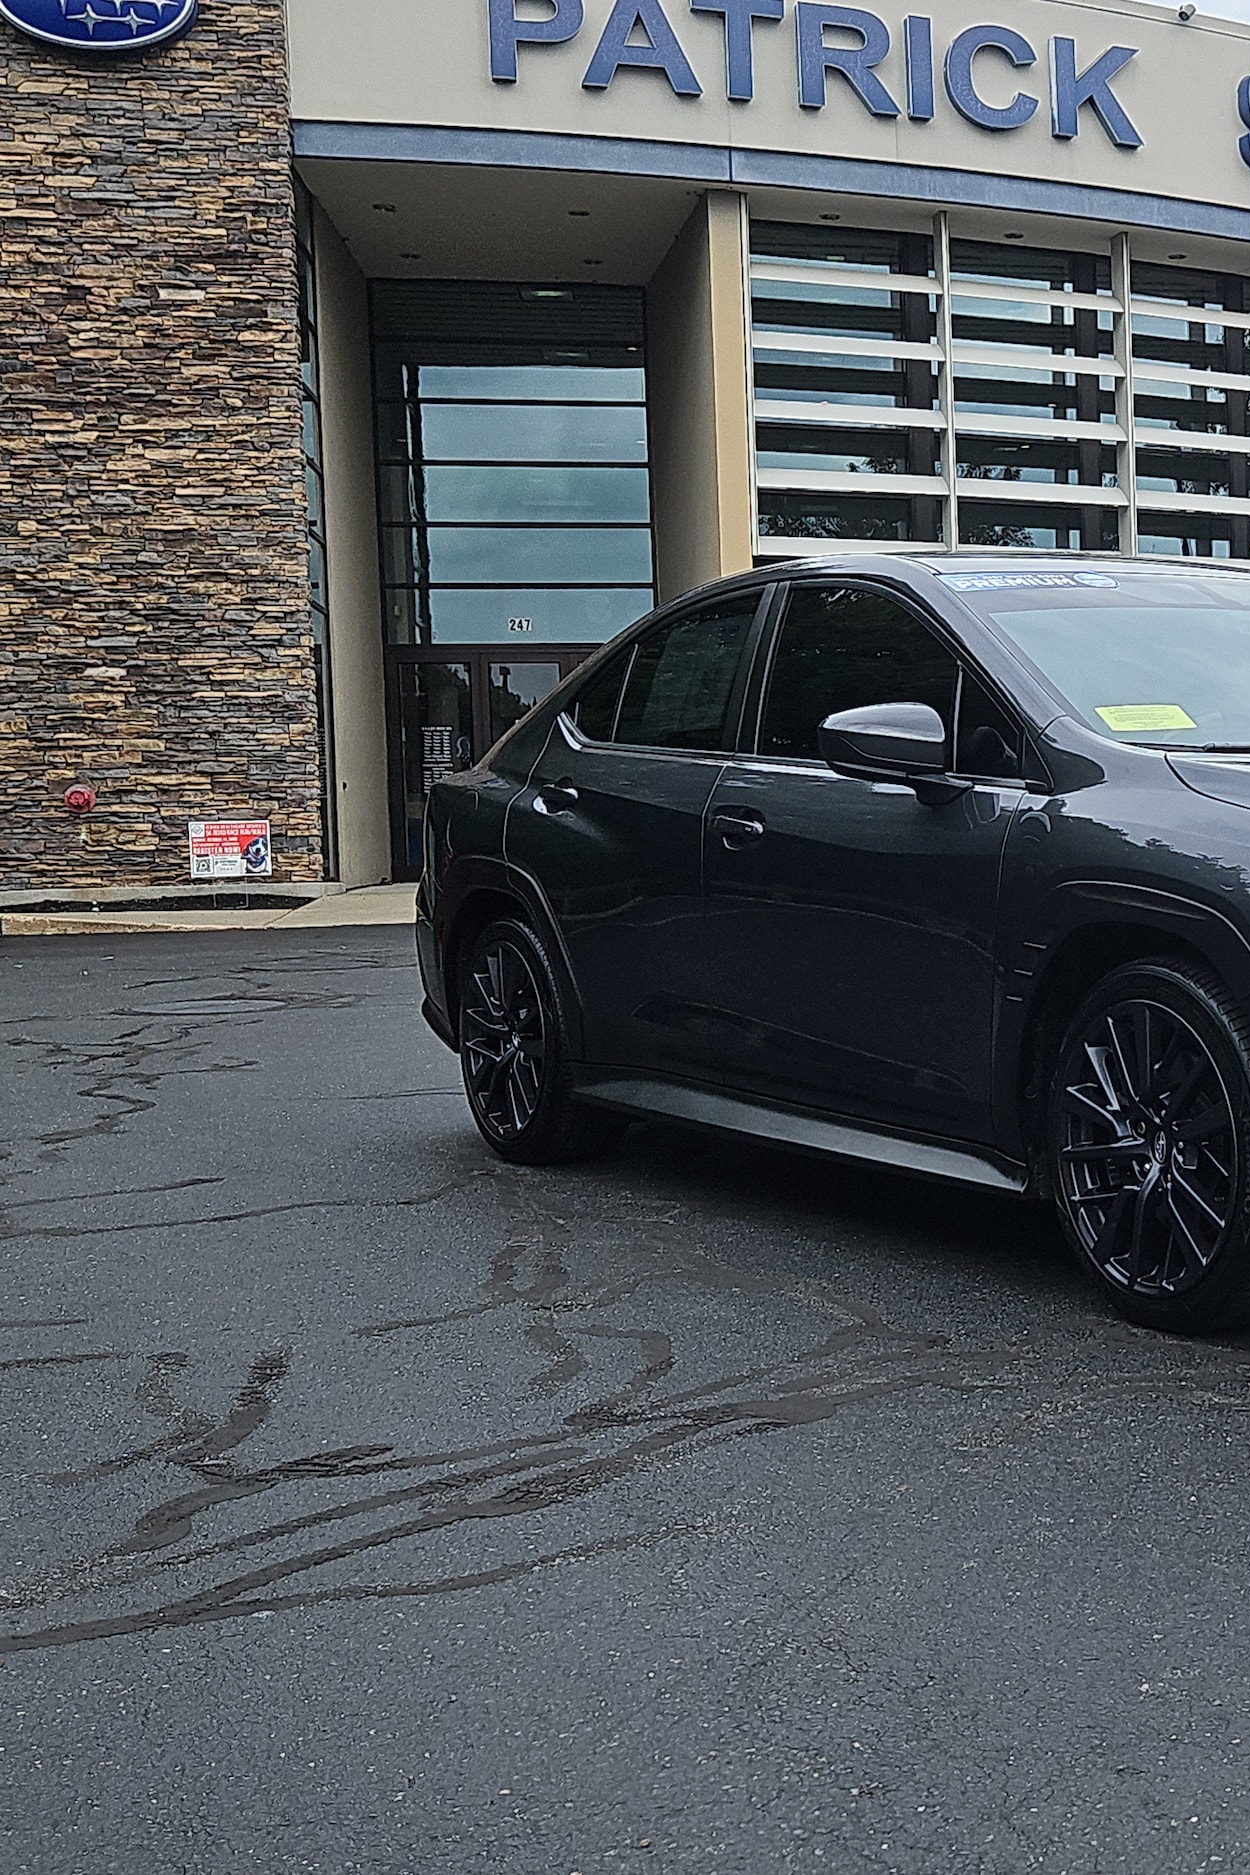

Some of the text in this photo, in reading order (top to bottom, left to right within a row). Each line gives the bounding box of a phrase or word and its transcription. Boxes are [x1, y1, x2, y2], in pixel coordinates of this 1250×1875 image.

[488, 0, 1145, 149] PATRICK
[952, 577, 1077, 589] PREMIUM
[509, 619, 531, 631] 247
